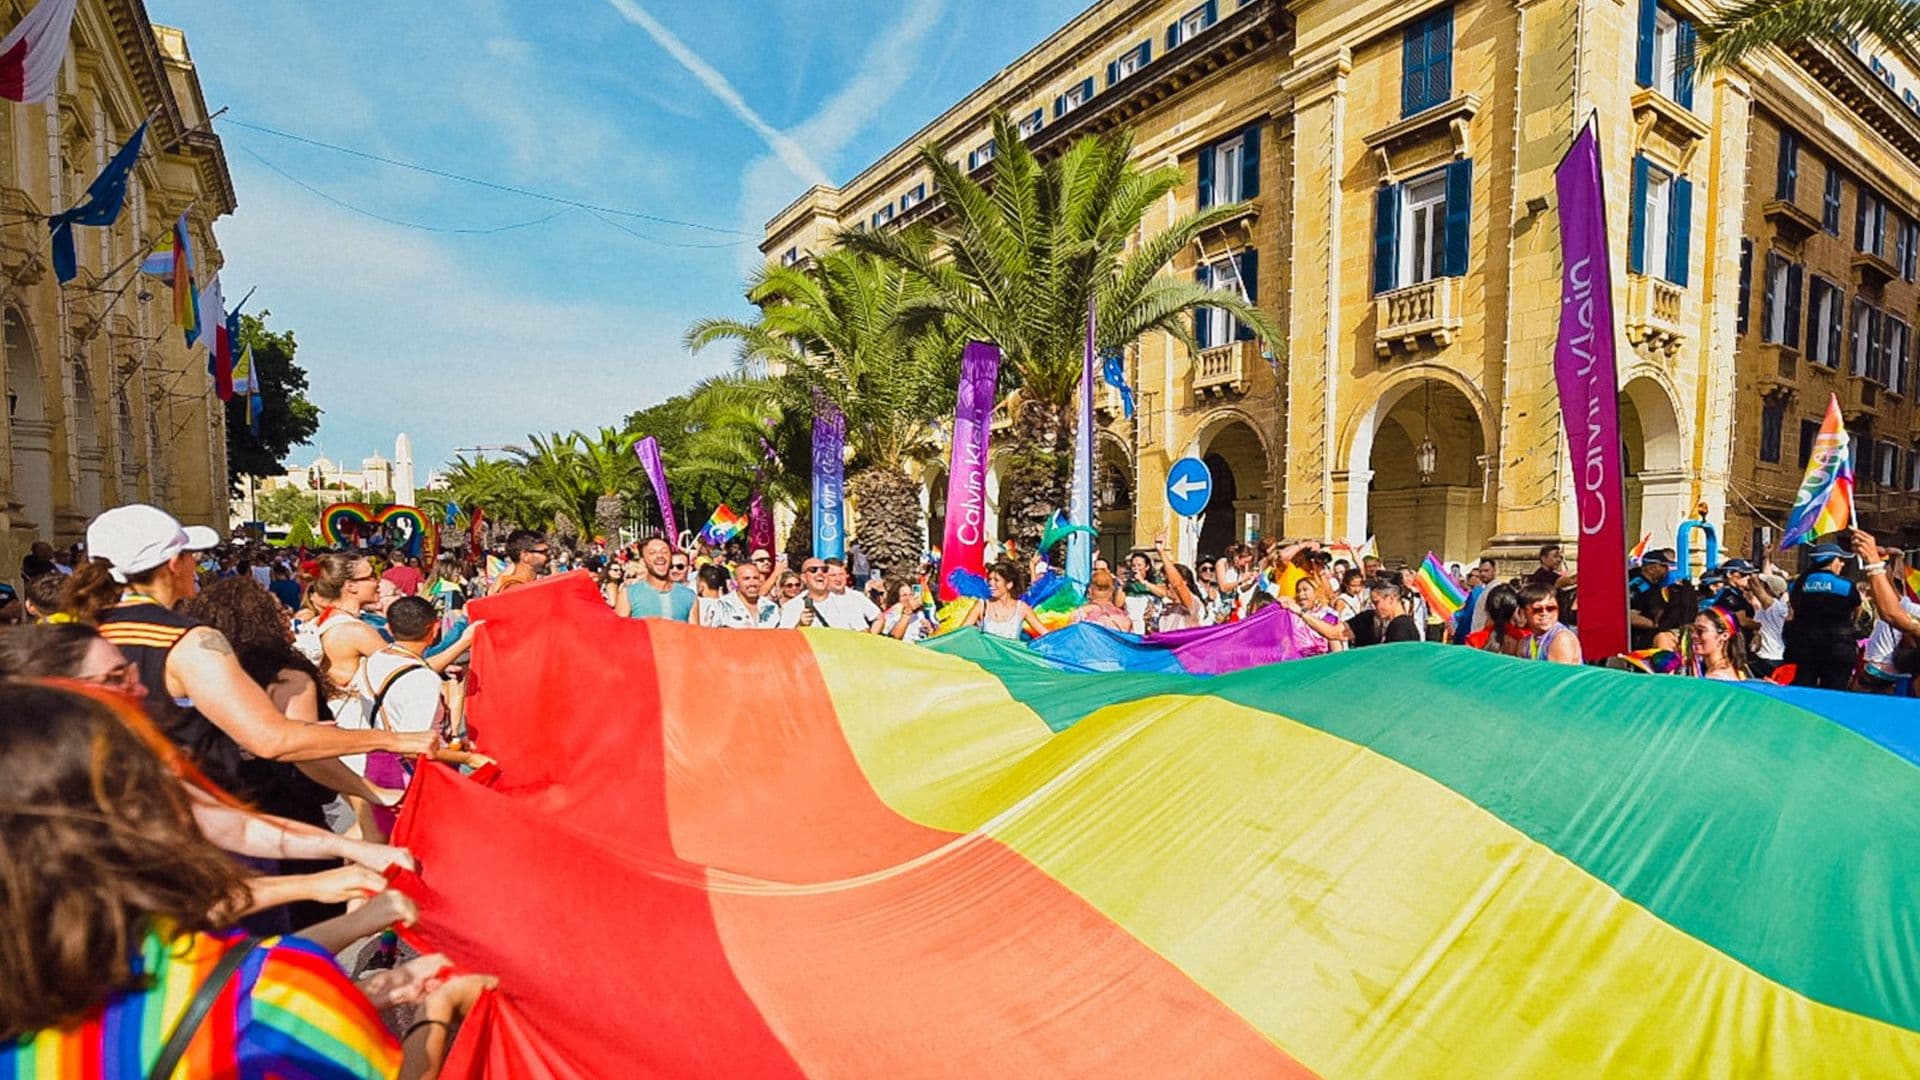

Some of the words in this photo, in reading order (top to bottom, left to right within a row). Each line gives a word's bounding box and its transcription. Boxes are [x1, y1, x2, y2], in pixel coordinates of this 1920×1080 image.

[964, 408, 982, 466] Klein
[820, 482, 837, 542] Calvin
[957, 470, 982, 546] Calvin
